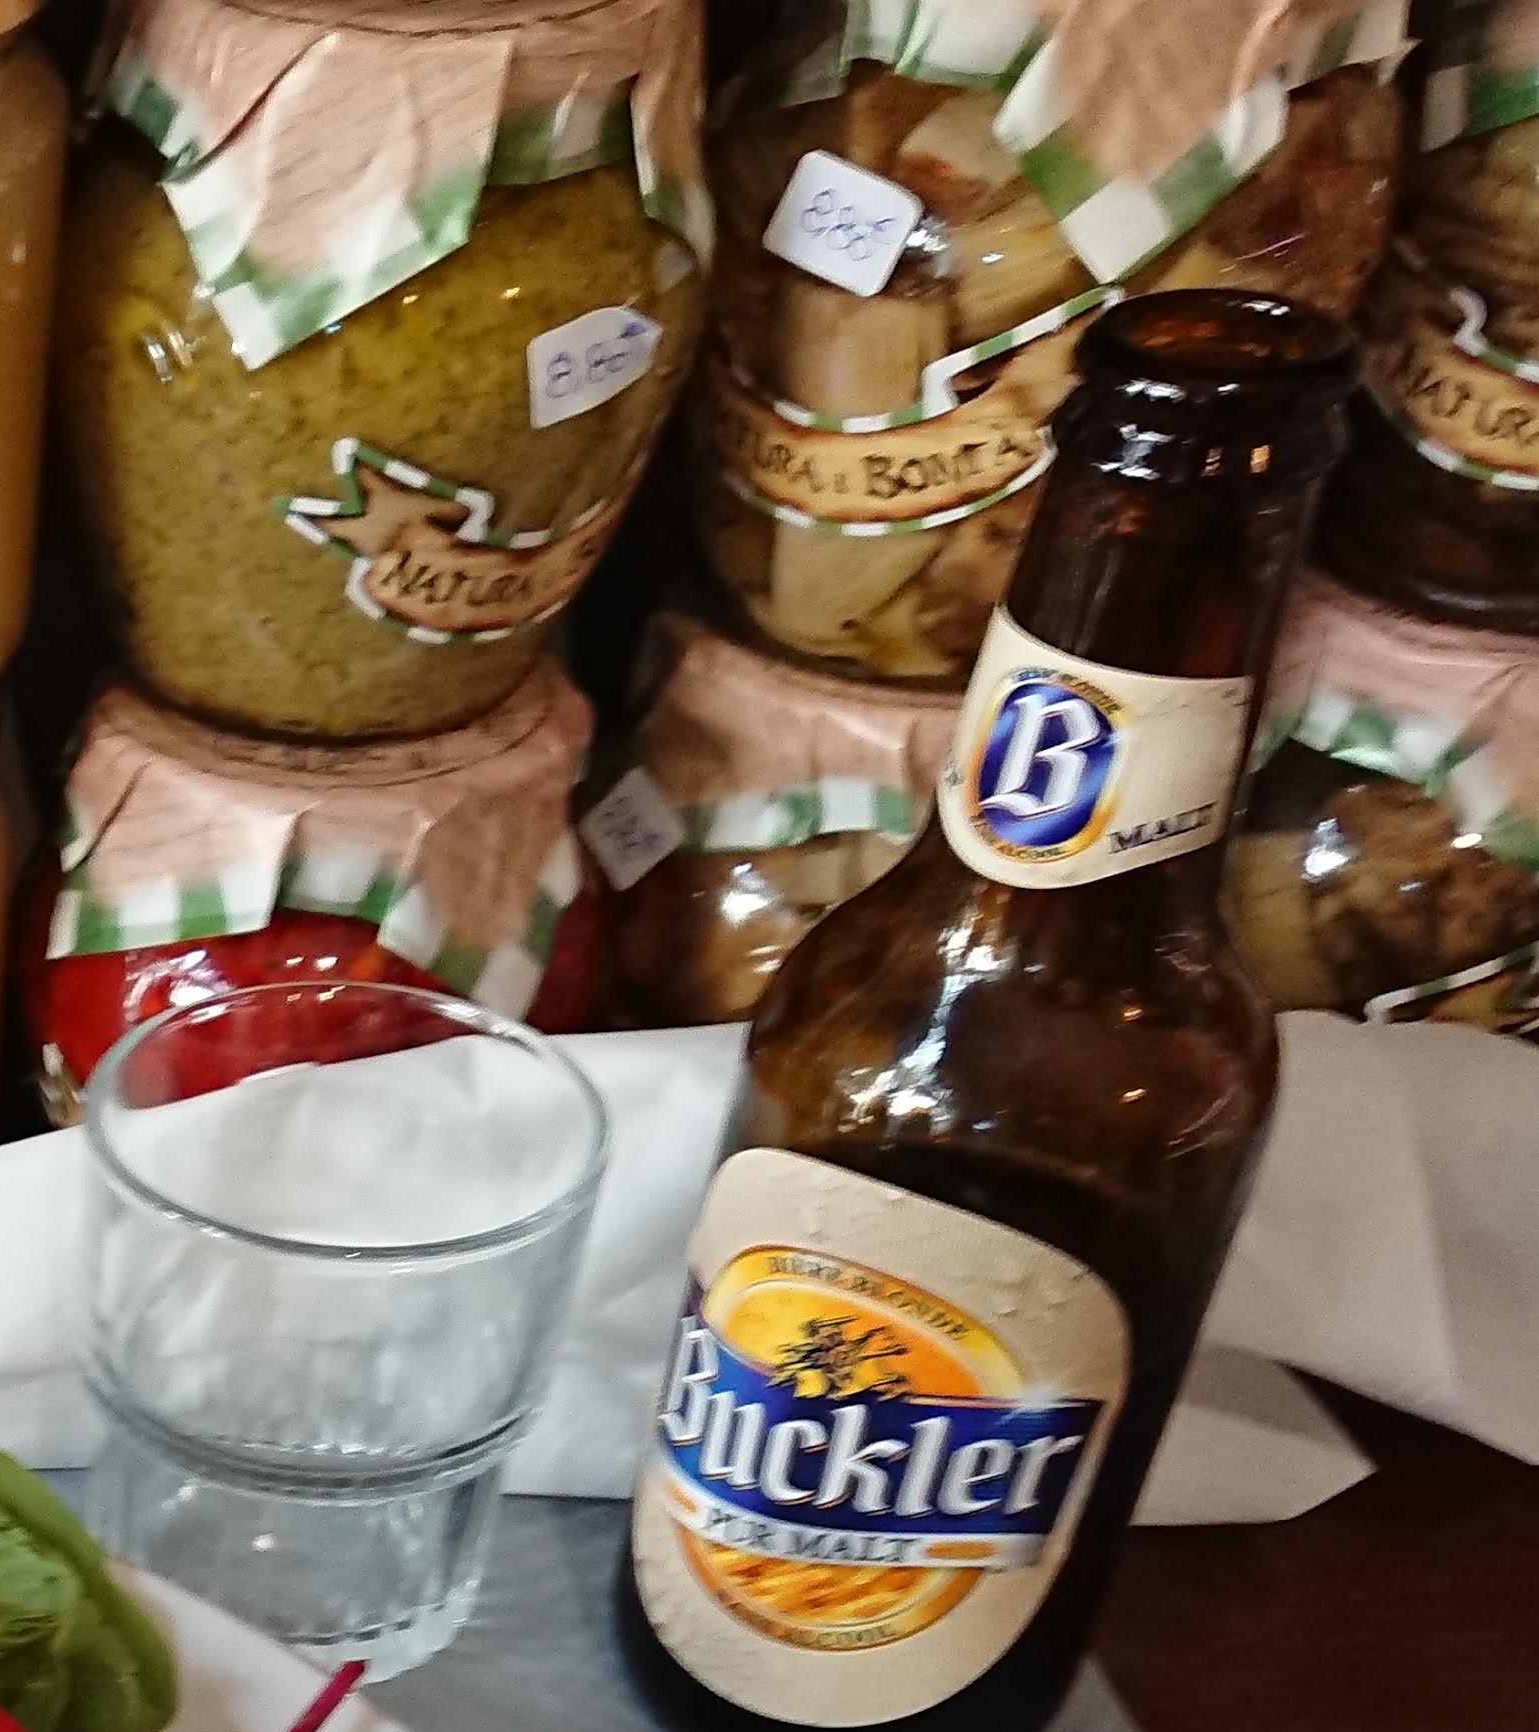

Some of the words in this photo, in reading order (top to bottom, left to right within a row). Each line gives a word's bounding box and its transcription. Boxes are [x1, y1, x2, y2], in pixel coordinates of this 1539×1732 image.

[979, 692, 1105, 822] B
[1107, 800, 1220, 856] MALT
[657, 1315, 1087, 1519] Buckler
